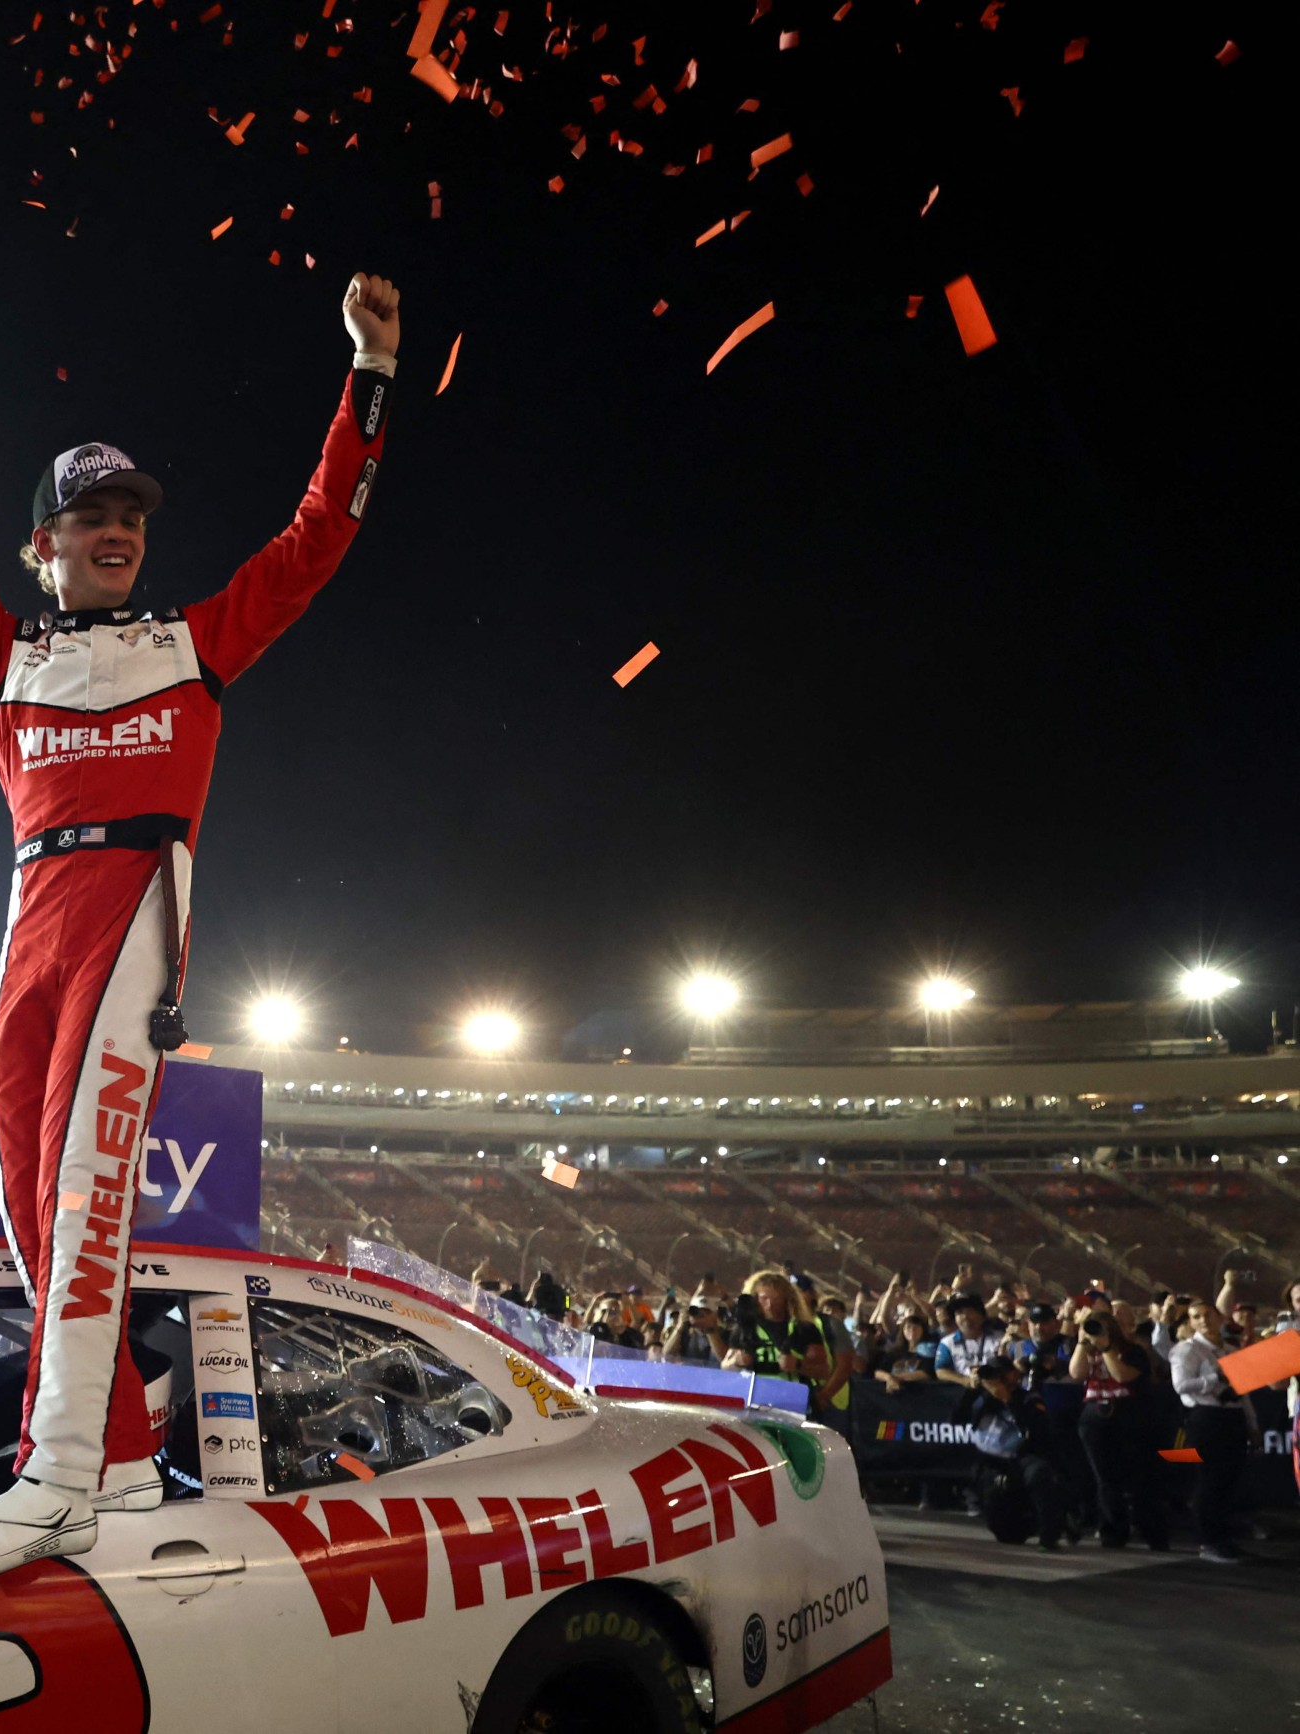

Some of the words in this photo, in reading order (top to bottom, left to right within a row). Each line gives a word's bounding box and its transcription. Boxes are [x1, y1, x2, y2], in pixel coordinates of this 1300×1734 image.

[365, 385, 384, 436] sparco
[14, 709, 173, 761] WHELEN
[22, 750, 106, 772] MANUFACTURED
[109, 750, 121, 758] IN
[124, 744, 171, 757] AMERICA
[60, 1052, 146, 1320] WHELEN
[196, 1325, 245, 1333] CHEVROLET
[199, 1356, 233, 1367] LUCAS
[234, 1358, 249, 1368] OIL
[229, 1436, 256, 1453] ptc
[209, 1476, 258, 1486] COMETIC
[245, 1424, 778, 1637] WHELEN
[22, 1538, 61, 1563] sparco
[776, 1574, 869, 1651] samsara
